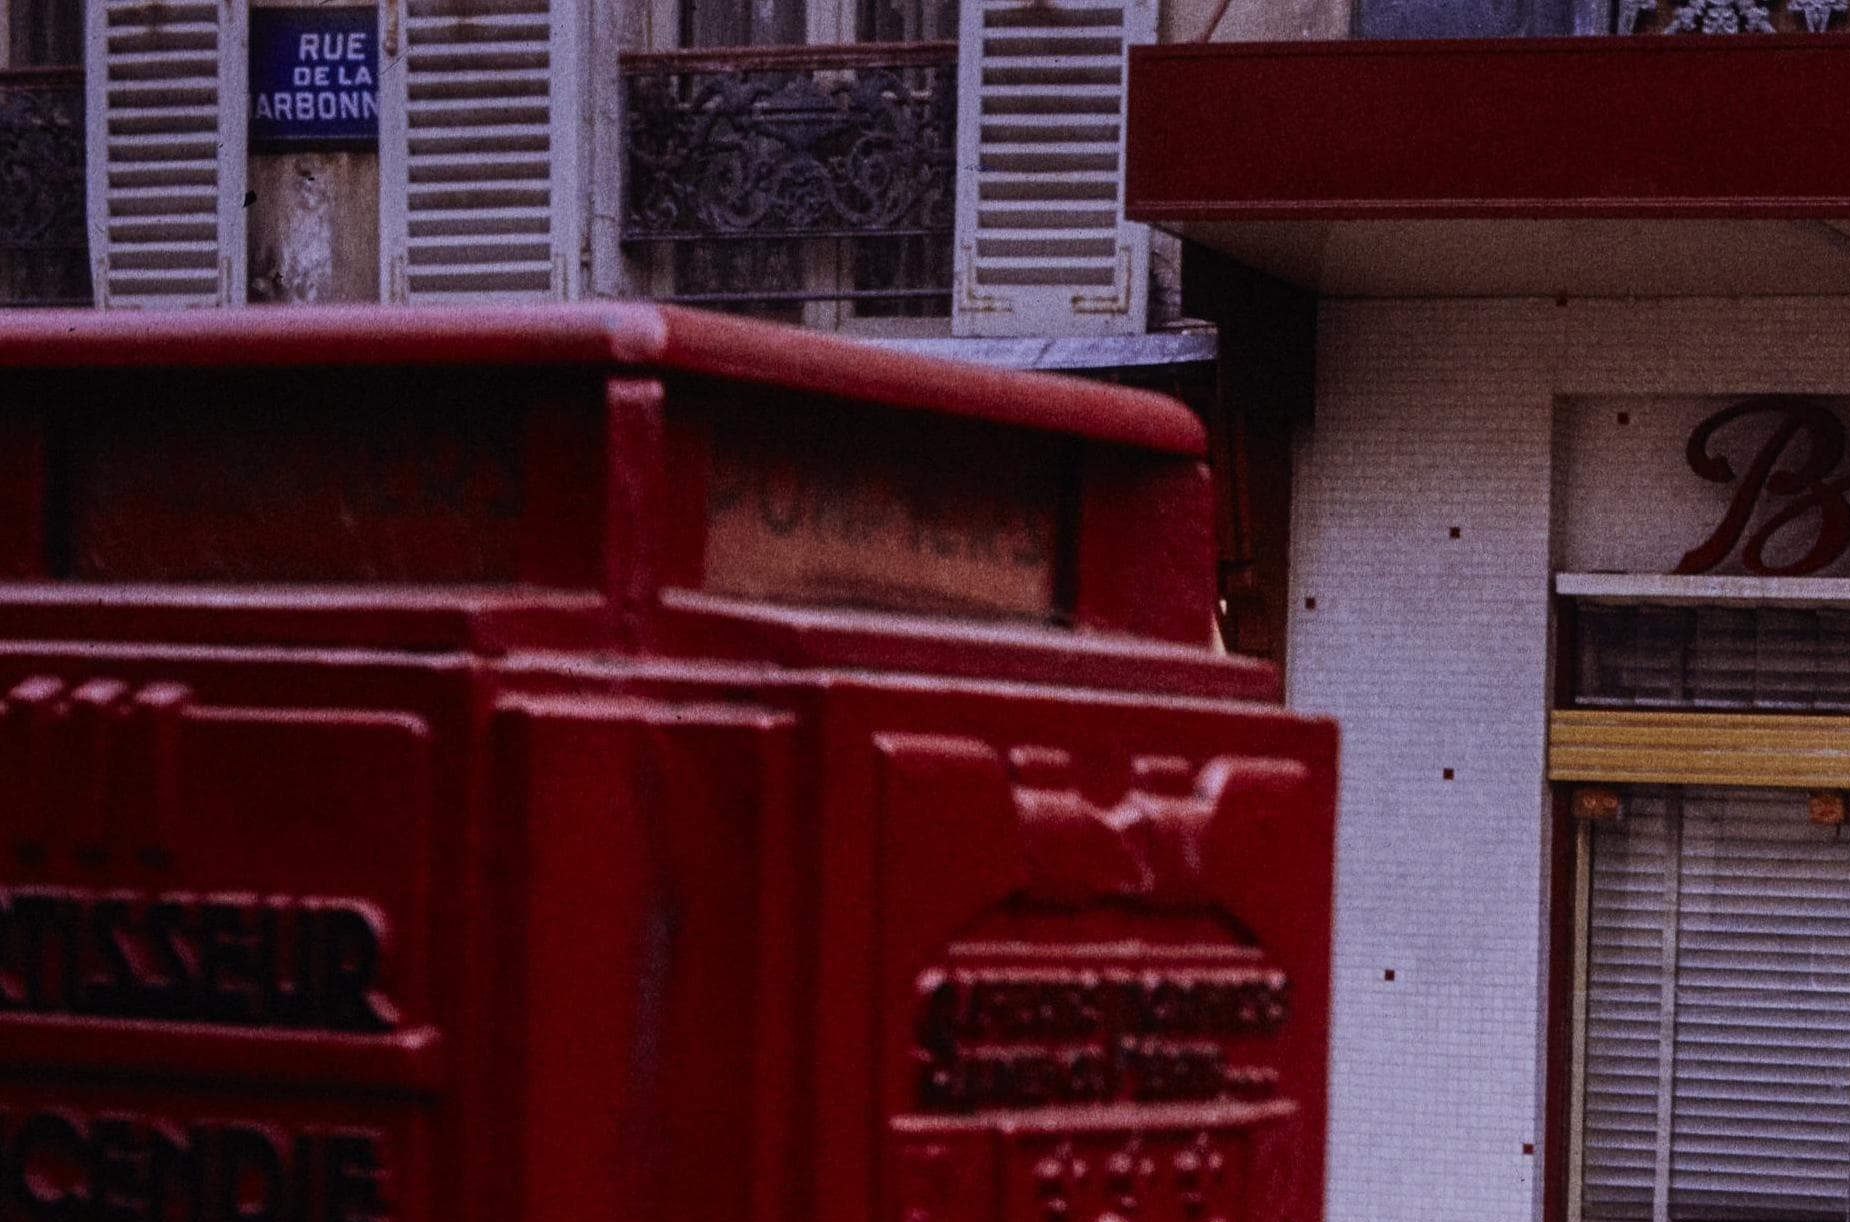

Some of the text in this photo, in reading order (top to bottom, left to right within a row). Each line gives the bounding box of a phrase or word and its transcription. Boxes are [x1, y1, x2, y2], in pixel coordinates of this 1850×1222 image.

[299, 32, 366, 61] RUE
[293, 66, 373, 86] DE LA
